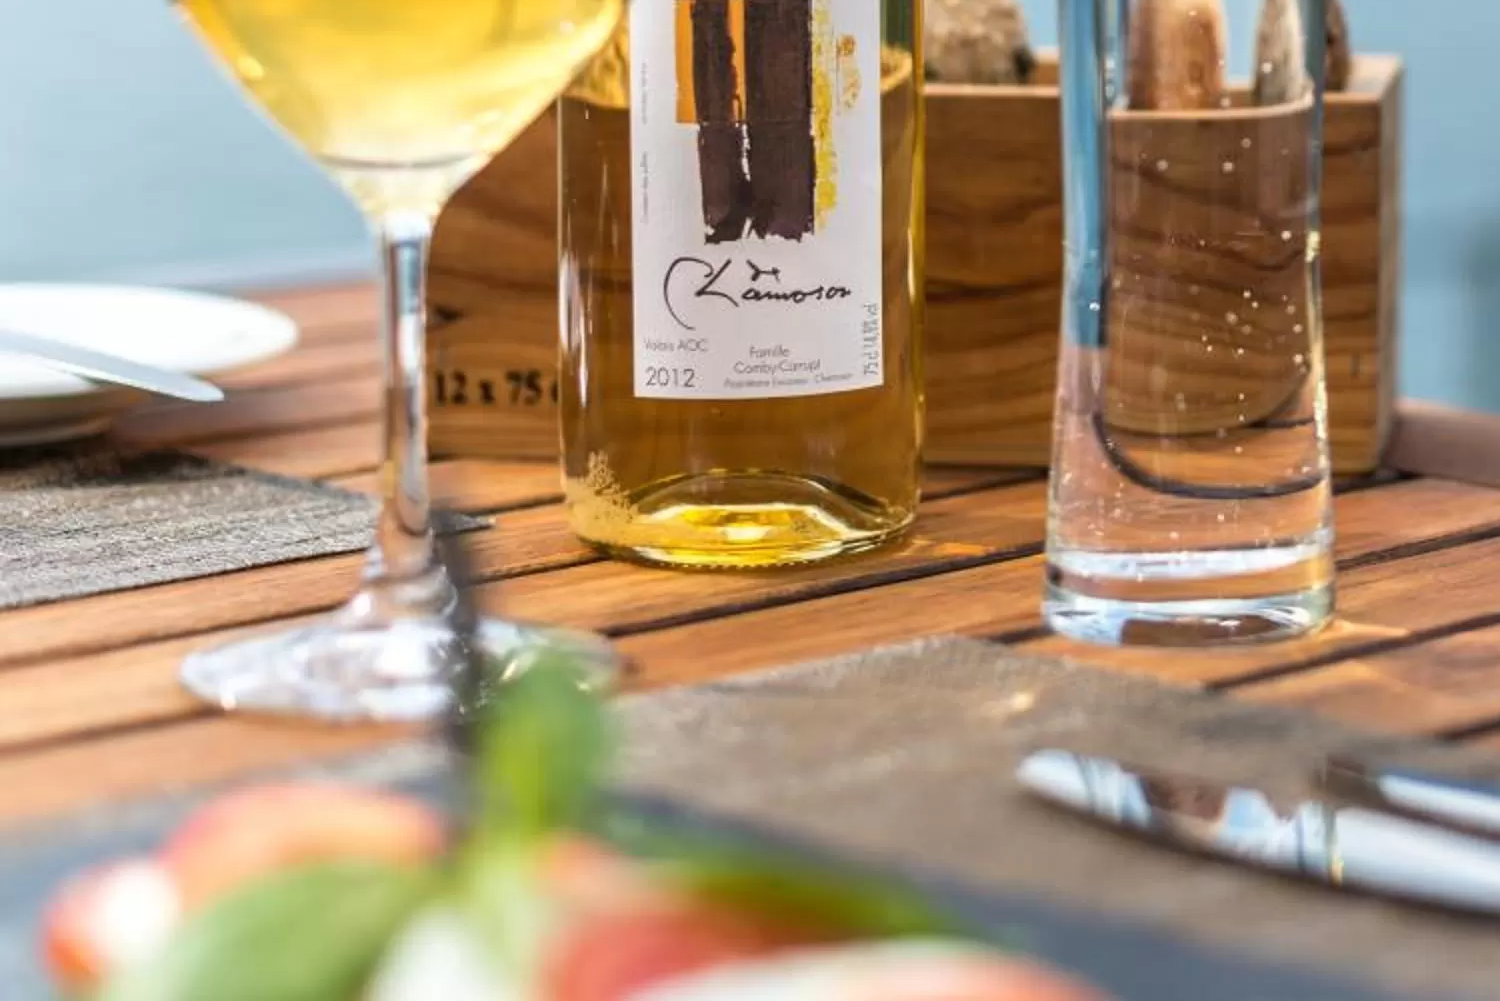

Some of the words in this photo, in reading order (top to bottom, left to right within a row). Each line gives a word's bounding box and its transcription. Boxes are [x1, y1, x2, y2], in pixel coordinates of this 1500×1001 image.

[677, 338, 709, 352] AOC
[434, 370, 468, 406] 12
[505, 369, 542, 406] 75
[645, 365, 696, 388] 2012
